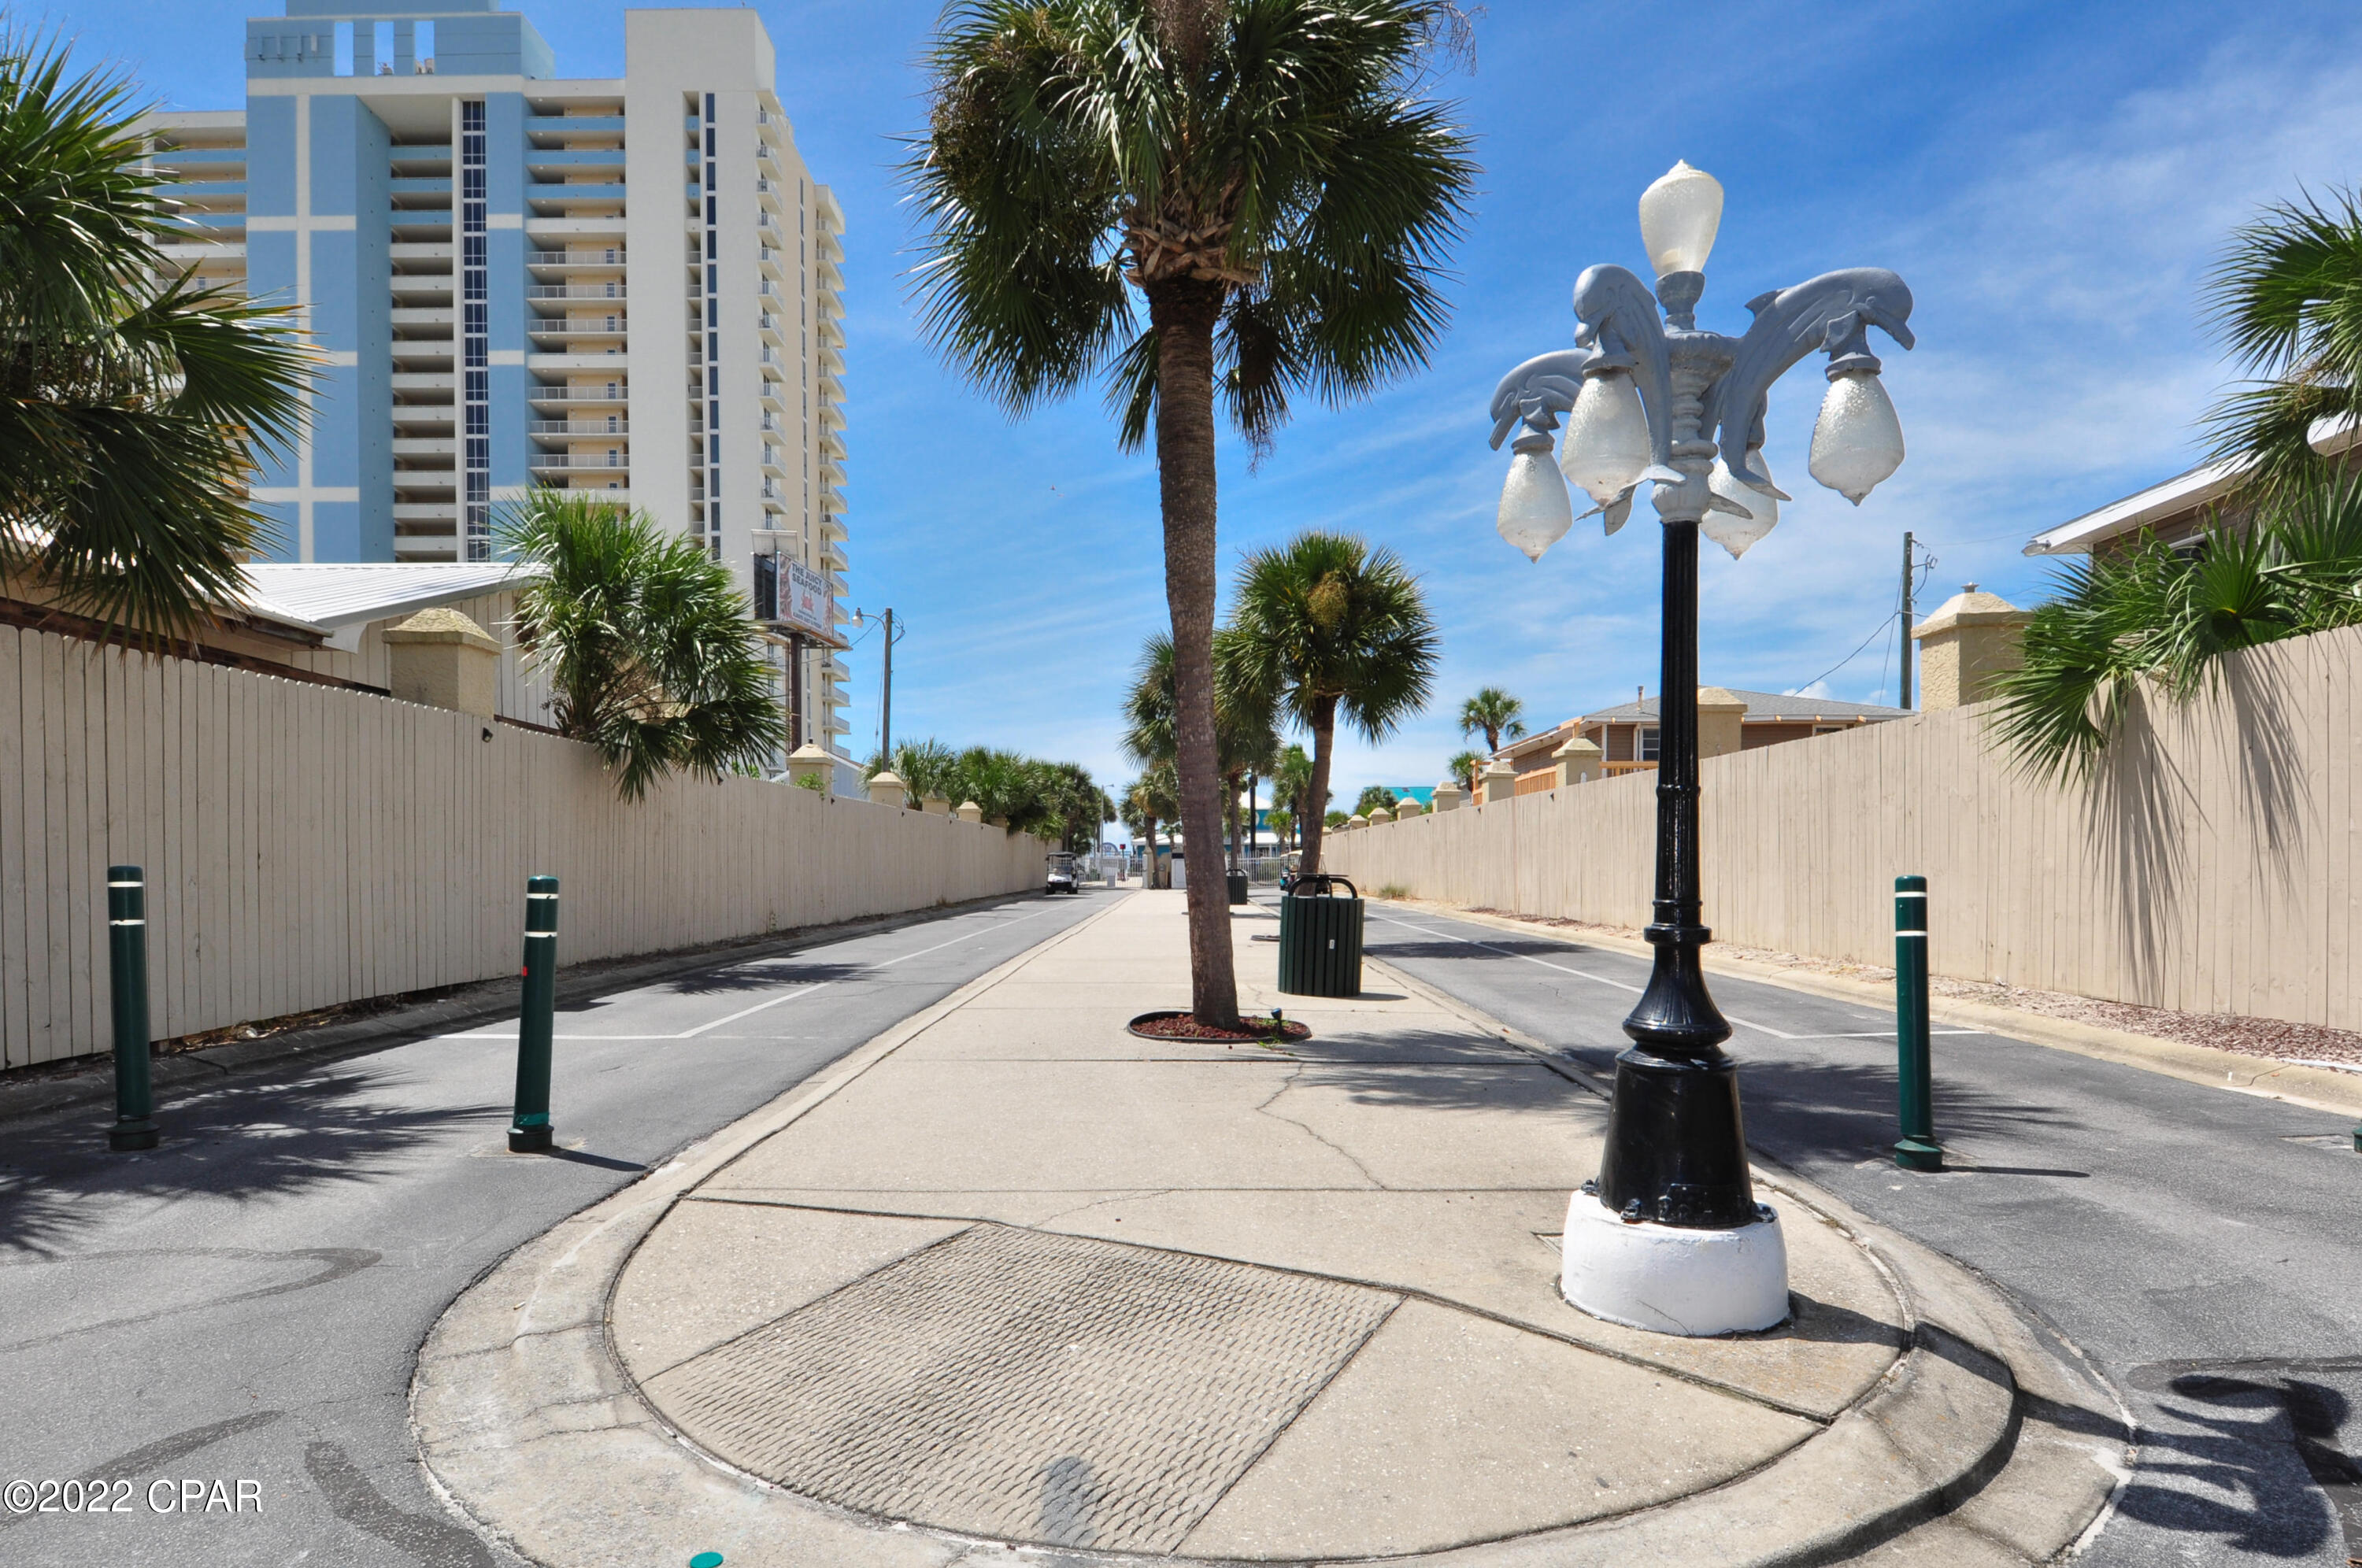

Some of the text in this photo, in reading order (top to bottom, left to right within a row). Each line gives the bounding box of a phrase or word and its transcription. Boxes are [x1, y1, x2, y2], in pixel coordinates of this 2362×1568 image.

[792, 563, 822, 586] THE JUICY
[792, 572, 822, 595] SEAFOOD
